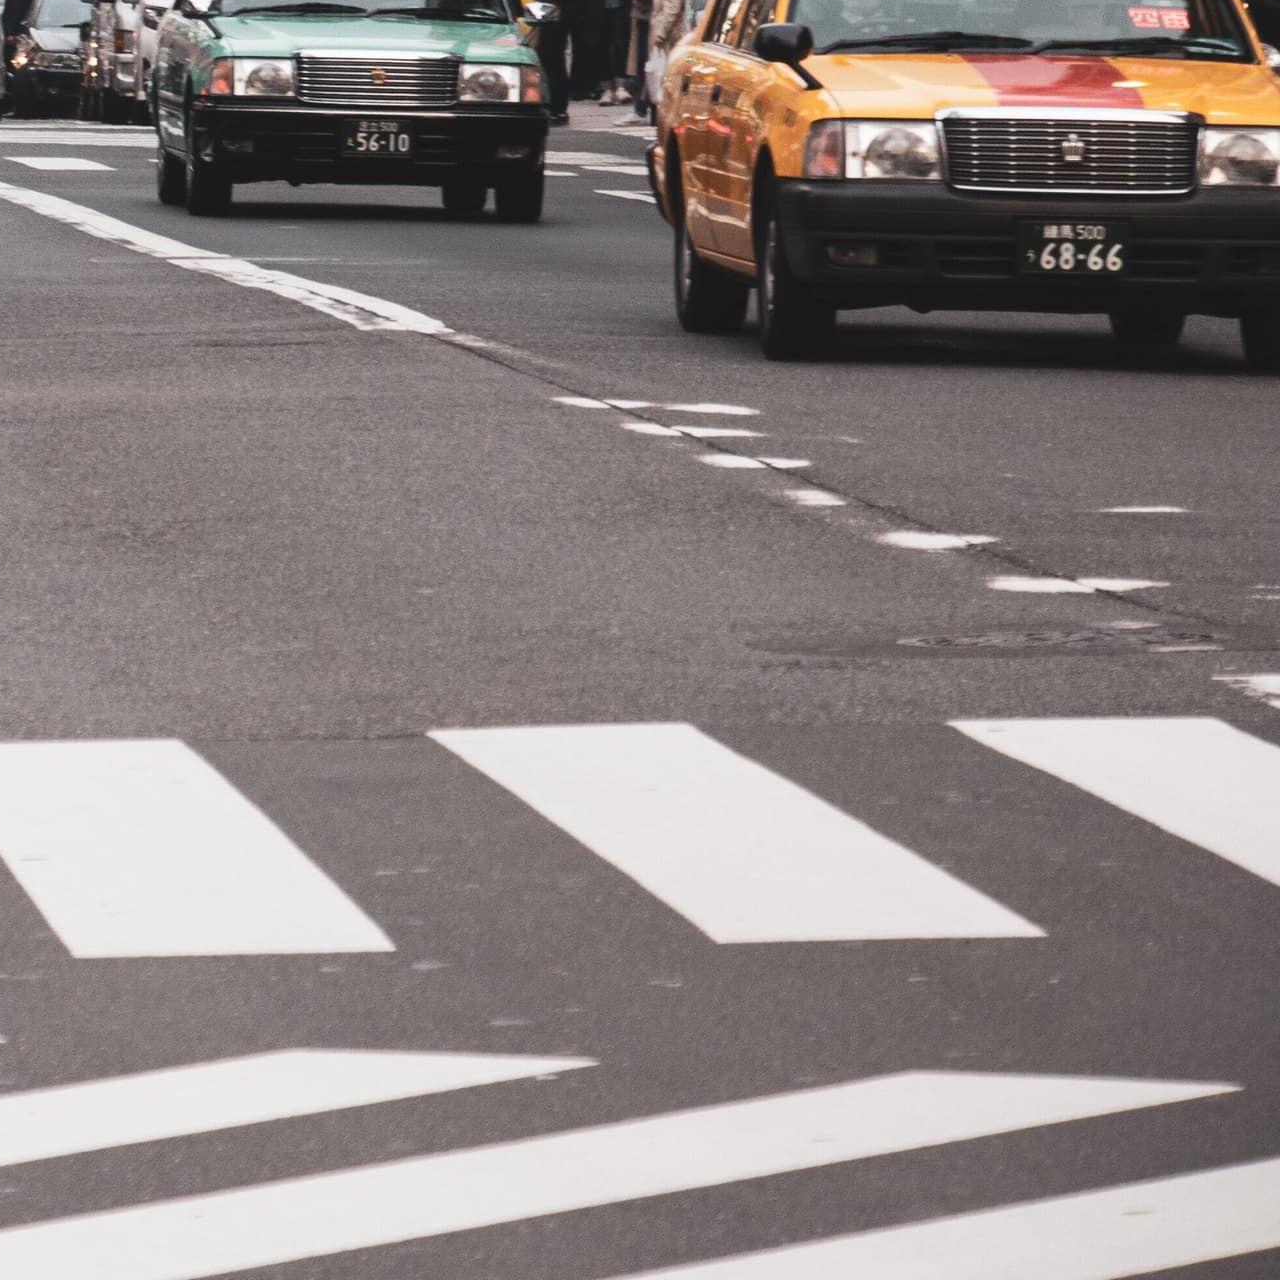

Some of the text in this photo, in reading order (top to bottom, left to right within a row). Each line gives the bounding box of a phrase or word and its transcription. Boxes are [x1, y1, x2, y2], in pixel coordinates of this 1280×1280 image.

[356, 132, 410, 152] 56-10
[1075, 225, 1106, 240] 500
[1039, 241, 1124, 272] 68-66
